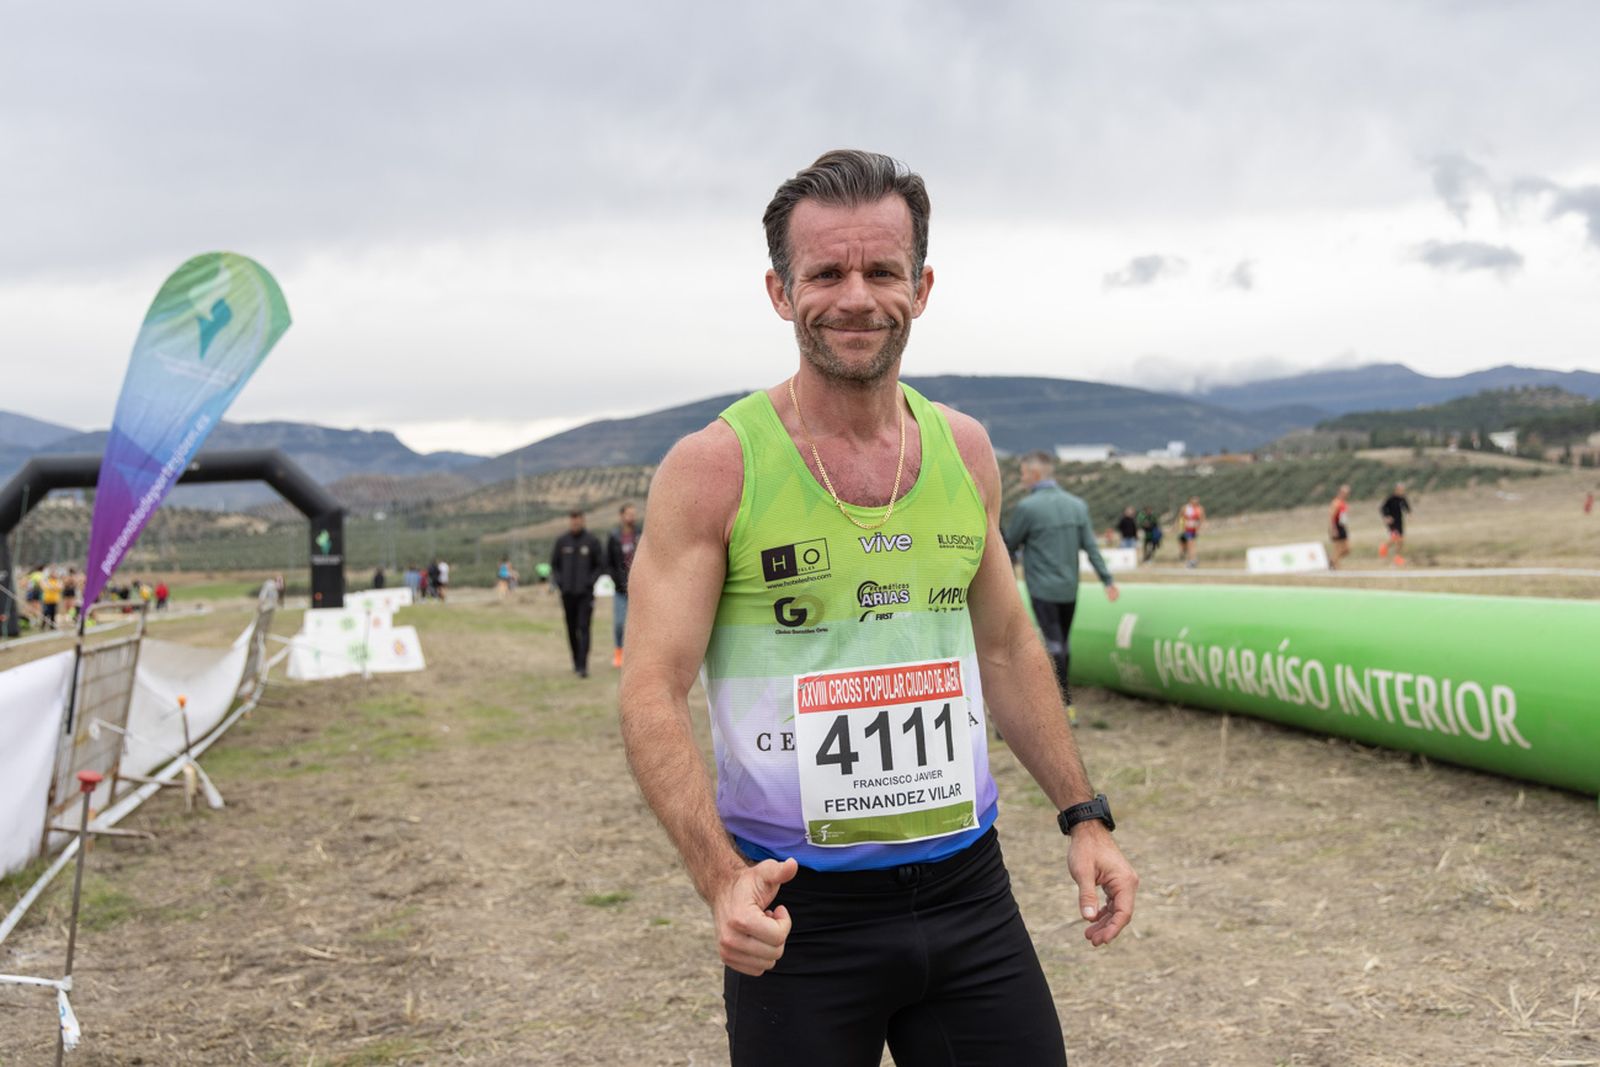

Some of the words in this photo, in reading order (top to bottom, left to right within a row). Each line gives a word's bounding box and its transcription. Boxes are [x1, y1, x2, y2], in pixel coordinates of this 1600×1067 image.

[858, 531, 913, 553] vive
[860, 590, 911, 607] ARIAS
[801, 680, 828, 707] XXVIII
[828, 676, 863, 705] CROSS
[863, 673, 907, 702] POPULAR
[905, 672, 934, 697] CIUDAD
[933, 670, 945, 693] DE
[1153, 626, 1209, 688] JAÉN
[1208, 637, 1330, 710] PARAÍSO
[1334, 662, 1532, 749] INTERIOR
[815, 703, 955, 775] 4111
[853, 775, 912, 789] FRANCISCO
[914, 769, 943, 783] JAVIER
[824, 790, 925, 813] FERNANDEZ
[928, 783, 962, 801] VILAR
